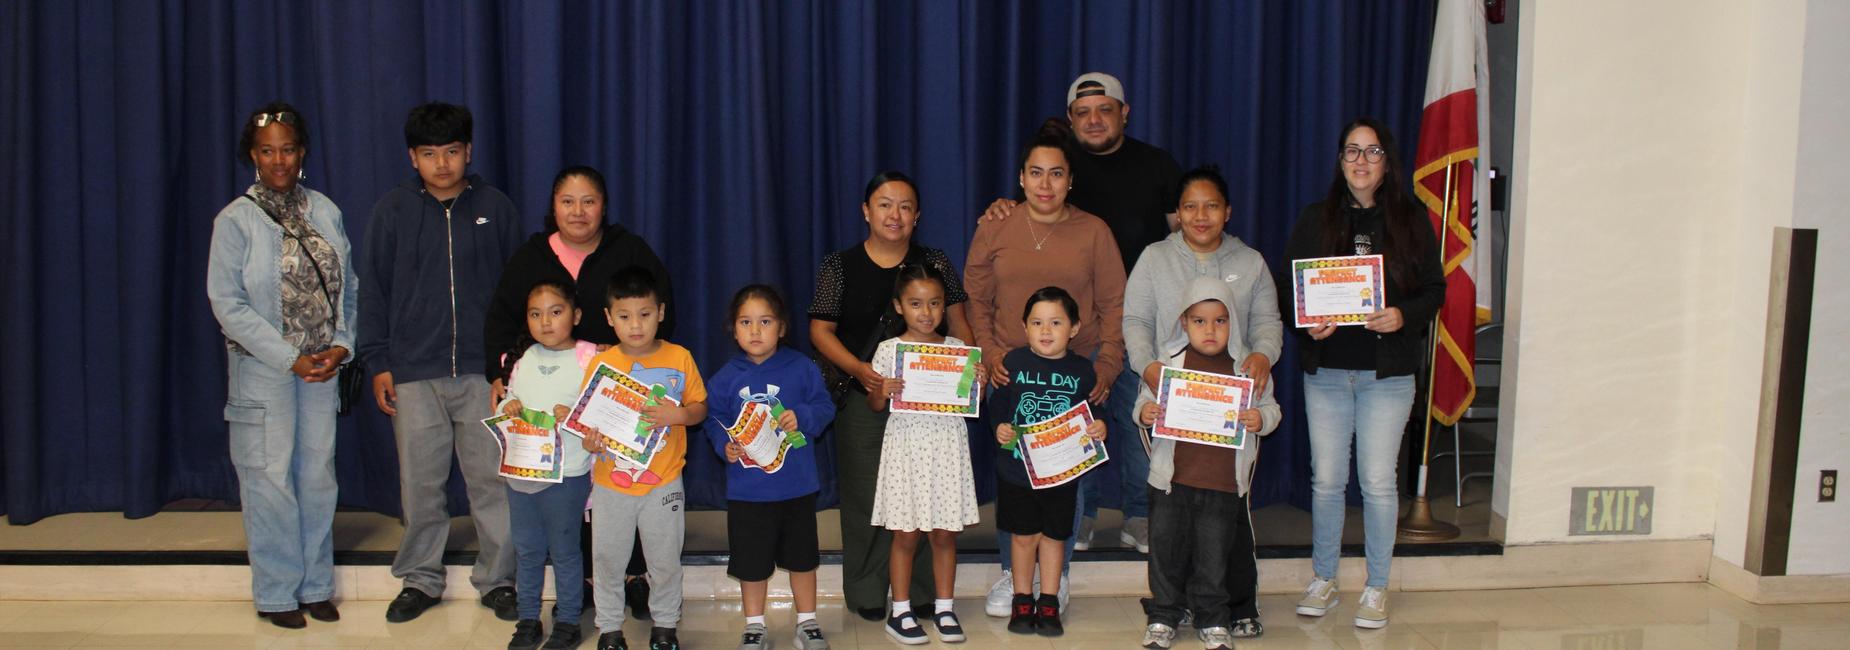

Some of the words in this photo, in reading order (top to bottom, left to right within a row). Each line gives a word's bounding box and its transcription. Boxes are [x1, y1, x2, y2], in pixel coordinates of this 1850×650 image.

[1310, 275, 1367, 285] ATTENDANCE
[1016, 370, 1047, 385] ALL
[1051, 372, 1080, 390] DAY
[1175, 388, 1234, 404] ATTENDANCE
[1585, 490, 1640, 531] EXIT
